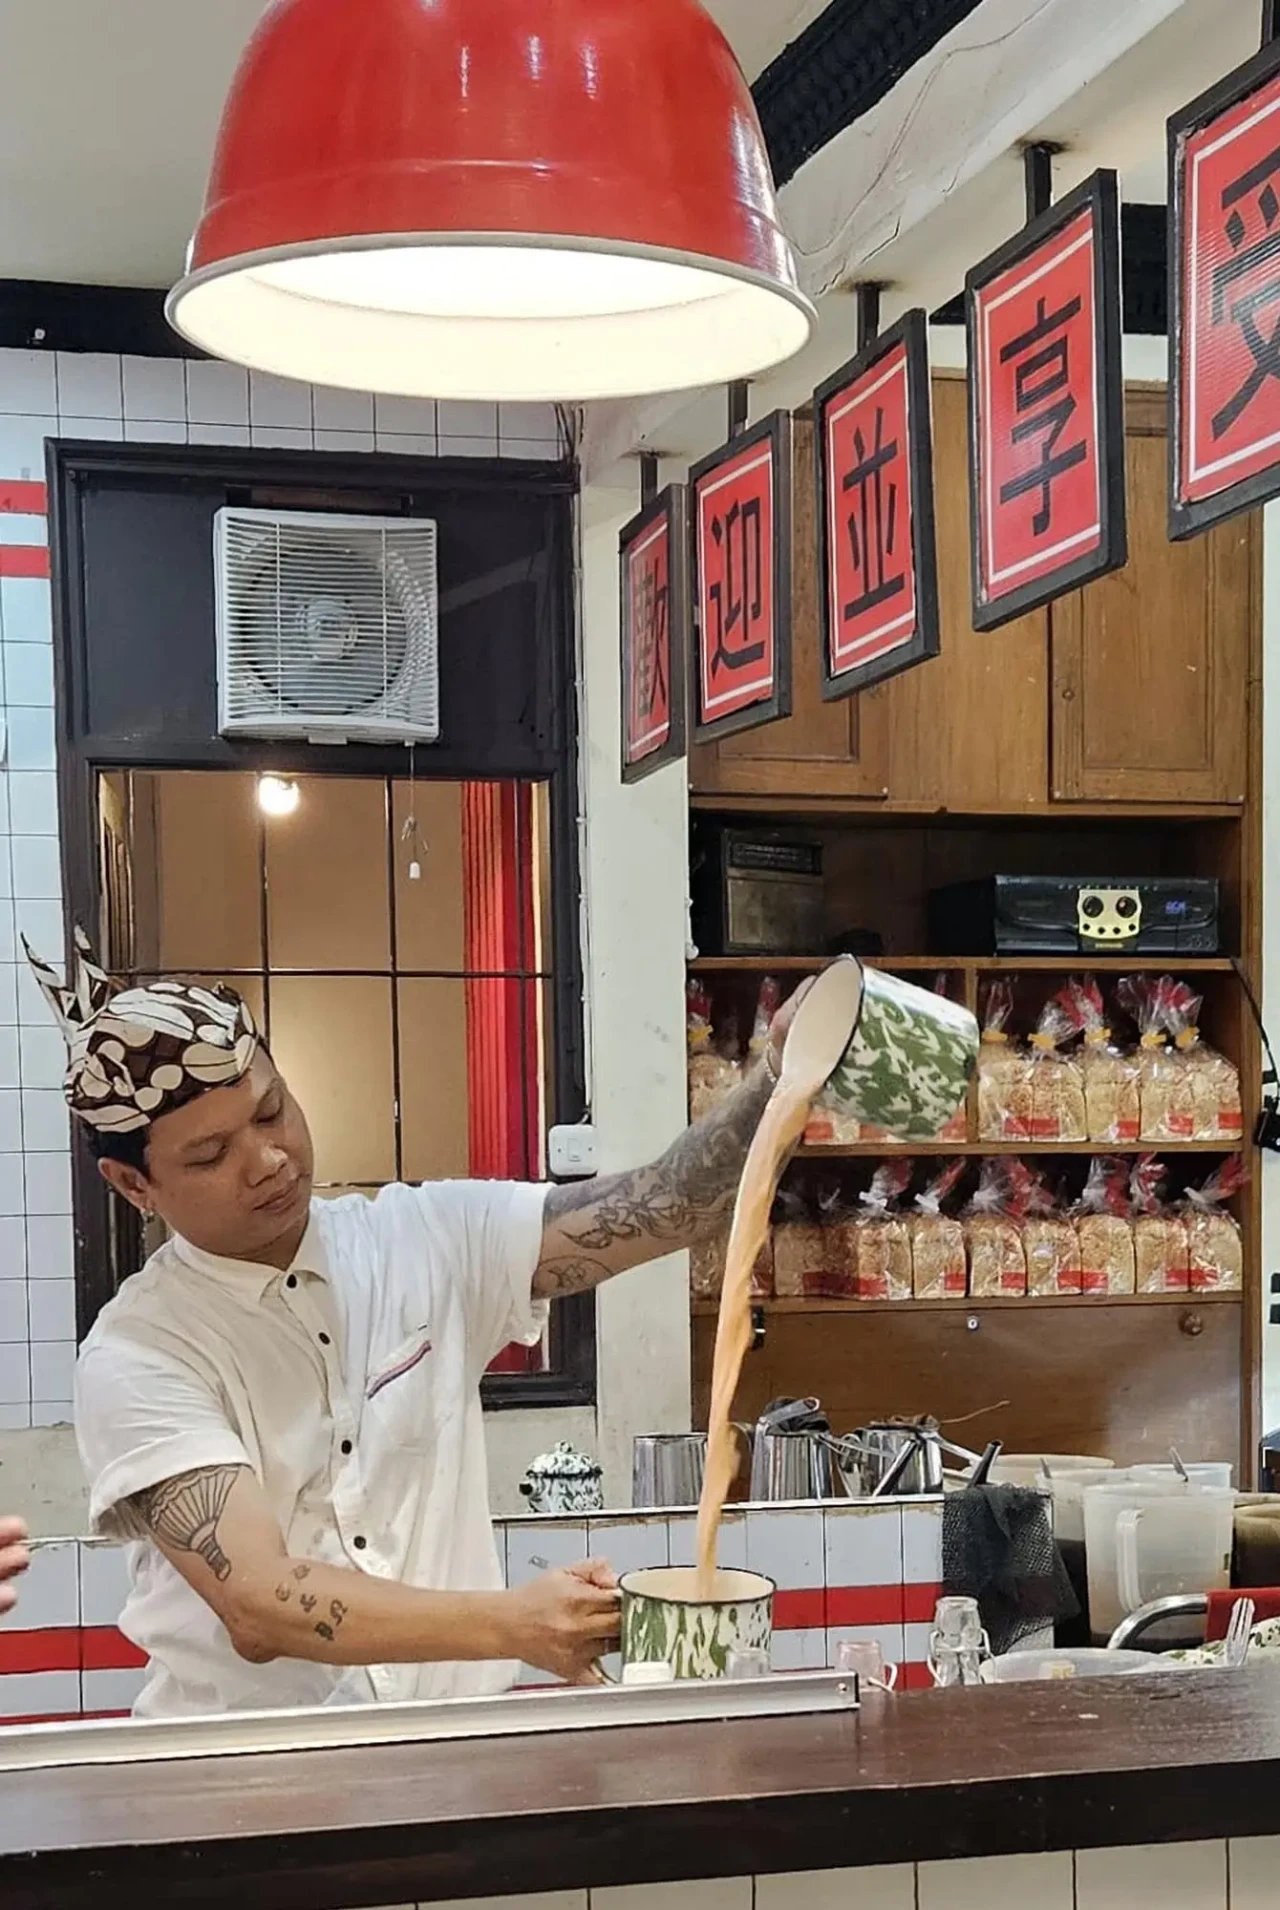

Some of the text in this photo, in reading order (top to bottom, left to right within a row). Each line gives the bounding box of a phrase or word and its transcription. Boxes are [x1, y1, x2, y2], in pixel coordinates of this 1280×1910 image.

[843, 407, 905, 622] 並
[1000, 295, 1086, 536] 享
[710, 496, 765, 680] 迎
